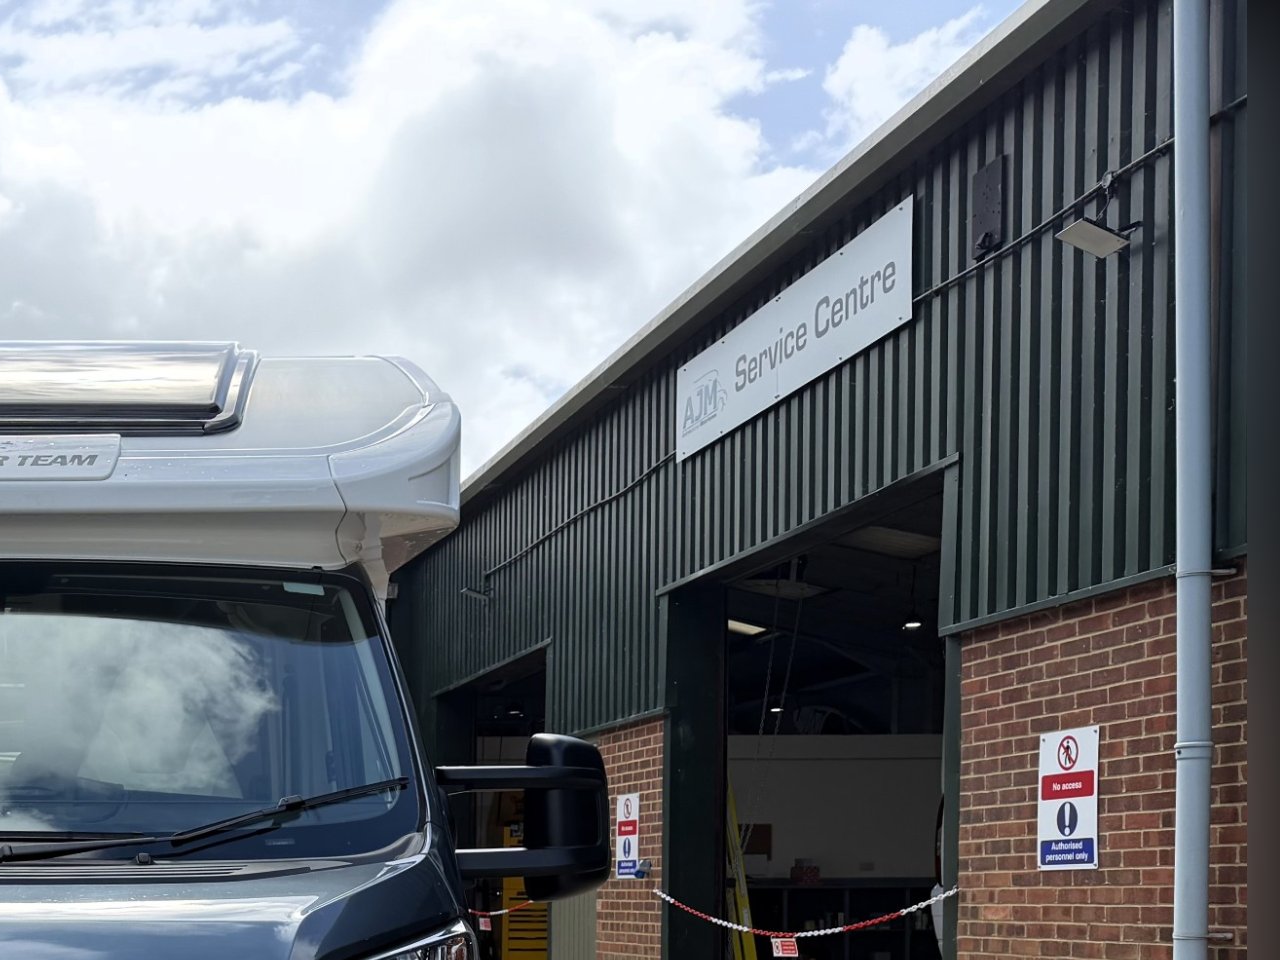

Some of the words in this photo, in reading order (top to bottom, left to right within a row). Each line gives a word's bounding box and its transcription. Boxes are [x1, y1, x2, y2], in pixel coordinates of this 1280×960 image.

[735, 322, 807, 392] Service
[814, 261, 896, 339] Centre
[682, 378, 718, 430] AJM
[17, 454, 98, 467] TEAM
[1052, 782, 1061, 791] No
[1061, 781, 1082, 790] access
[1051, 841, 1083, 850] Authorised
[1045, 852, 1075, 863] personnel
[1075, 853, 1088, 862] only
